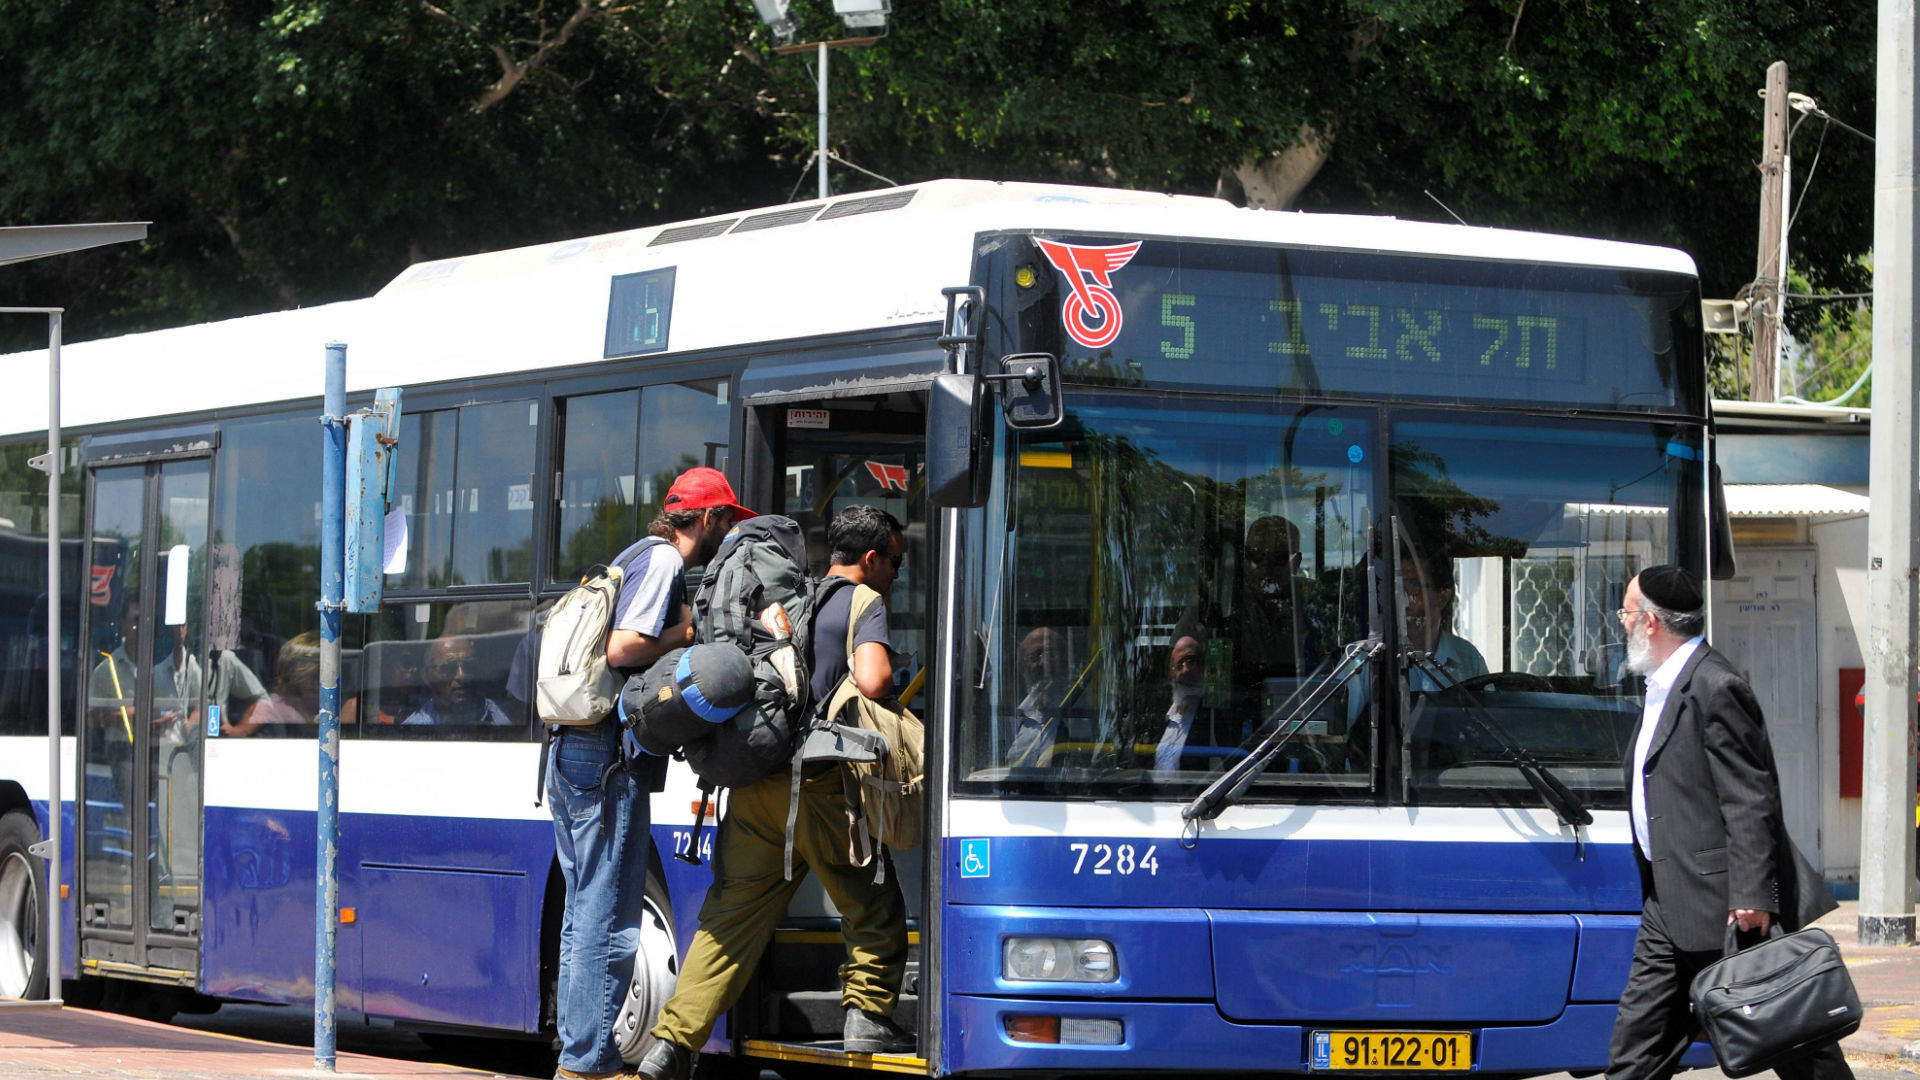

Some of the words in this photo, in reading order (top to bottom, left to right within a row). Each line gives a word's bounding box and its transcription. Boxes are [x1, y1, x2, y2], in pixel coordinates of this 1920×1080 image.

[1160, 293, 1196, 360] 5
[1268, 299, 1442, 363] אביב
[1473, 313, 1557, 369] תל
[673, 831, 712, 861] 724
[1069, 842, 1159, 876] 7284
[1337, 944, 1454, 975] MAN
